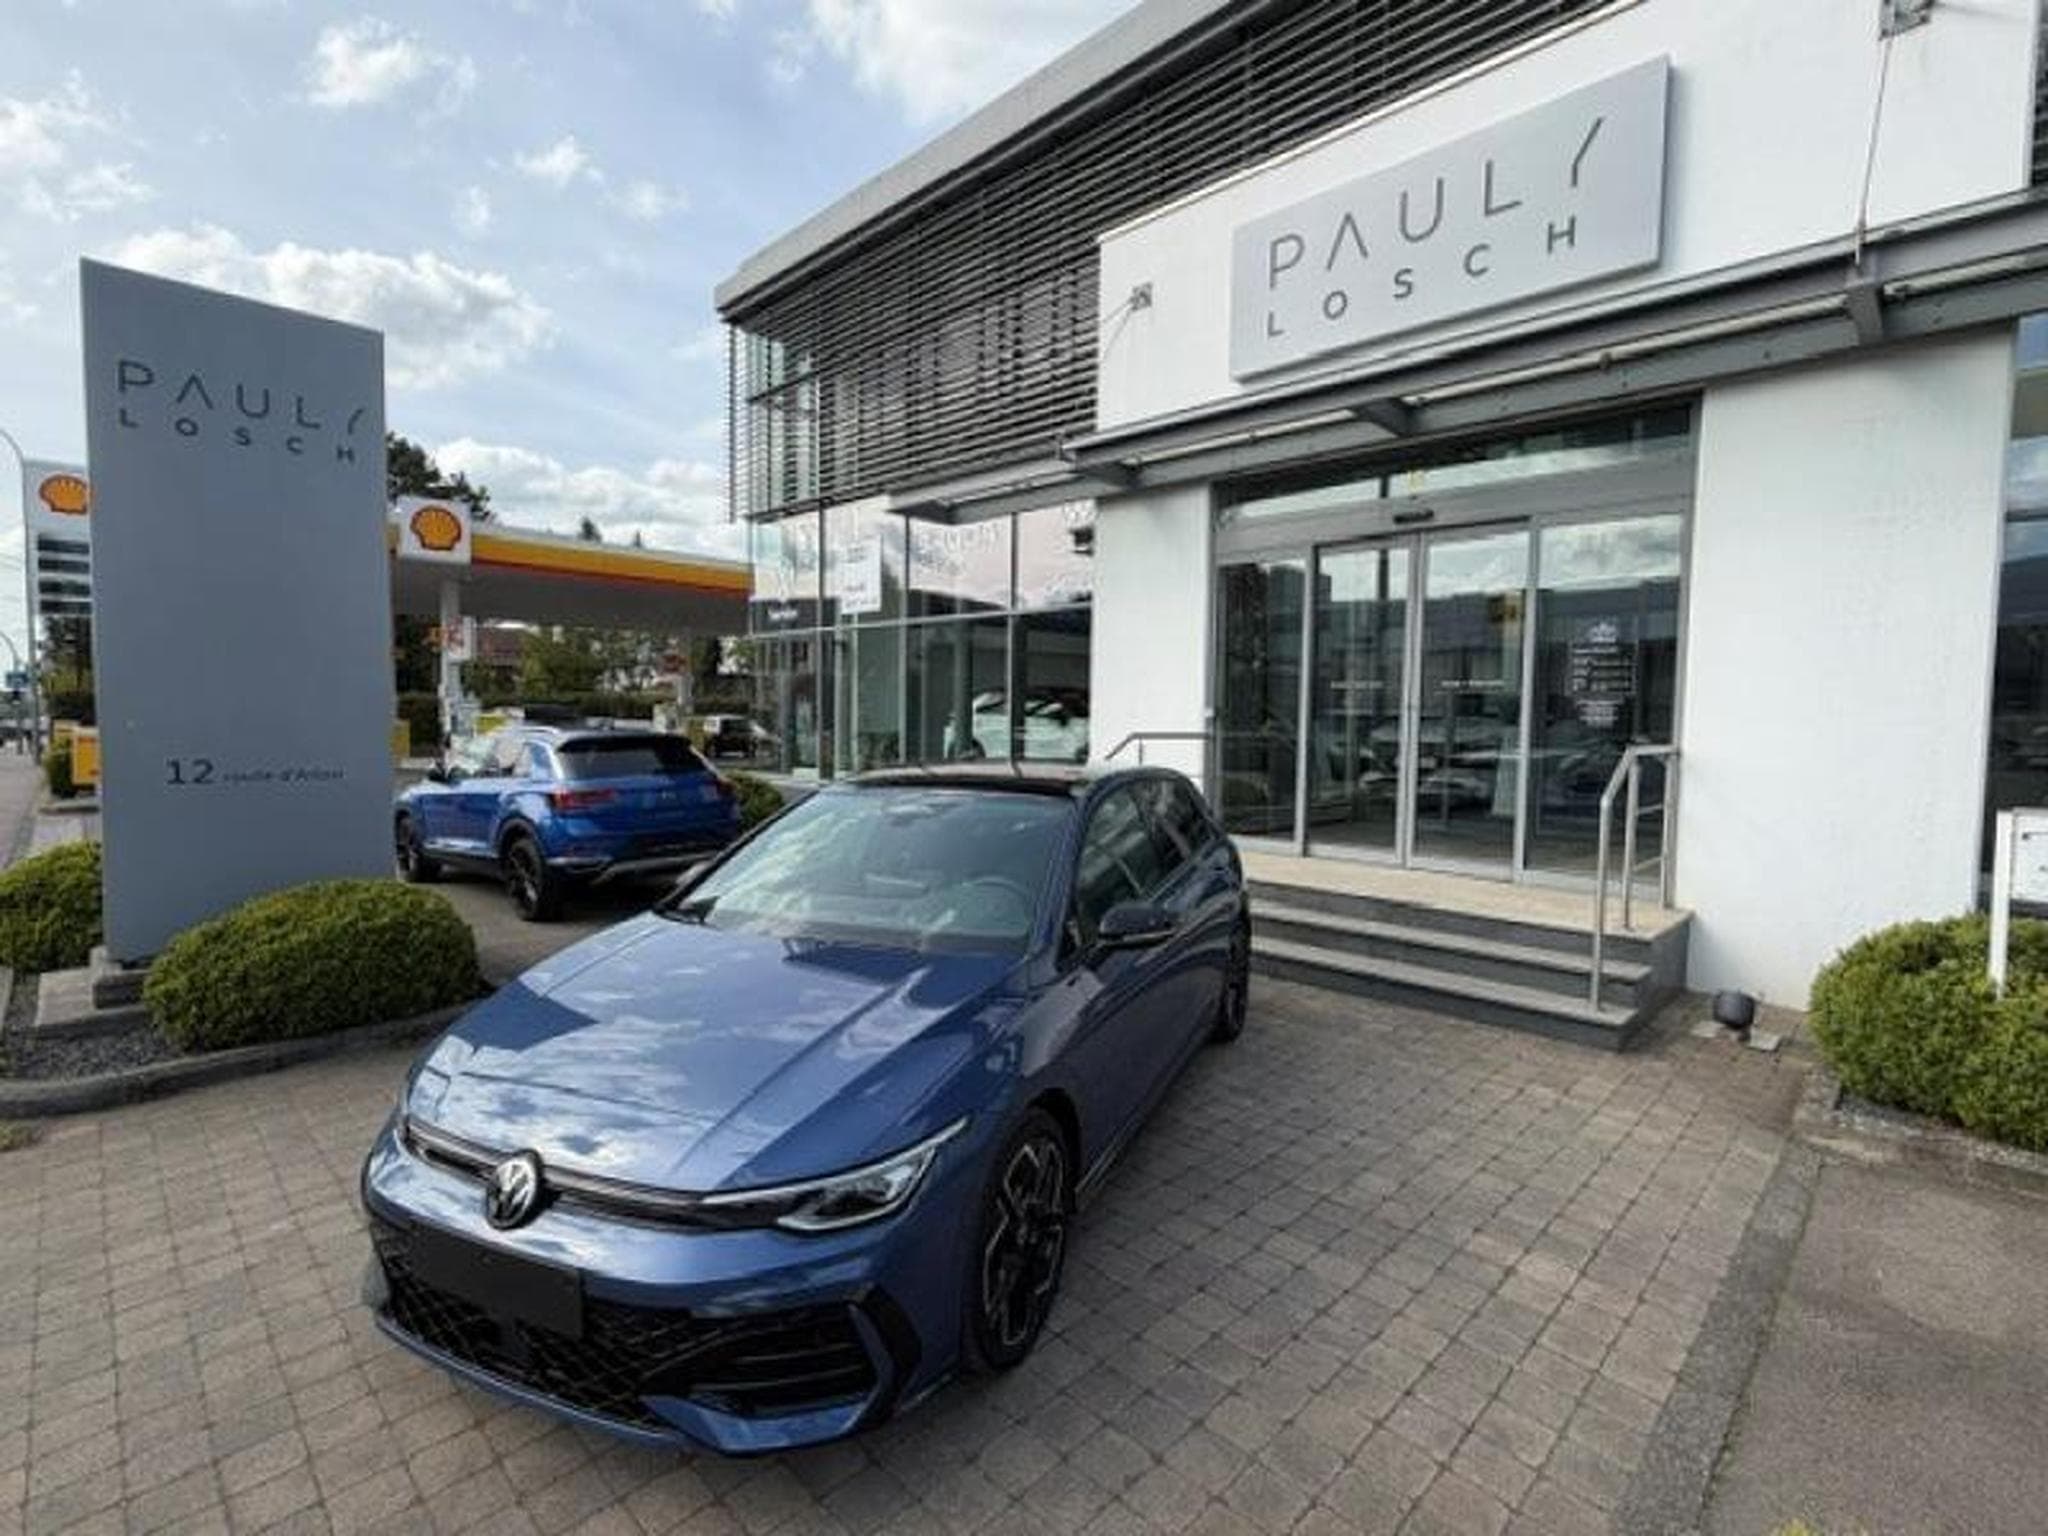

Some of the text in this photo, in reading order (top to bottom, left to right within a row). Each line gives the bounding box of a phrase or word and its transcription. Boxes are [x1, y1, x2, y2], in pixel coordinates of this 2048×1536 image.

[1268, 115, 1603, 290] PAULY
[1267, 214, 1577, 338] LOSCH
[117, 358, 366, 435] PAULY
[119, 407, 356, 463] LOSCH
[166, 758, 216, 785] 12
